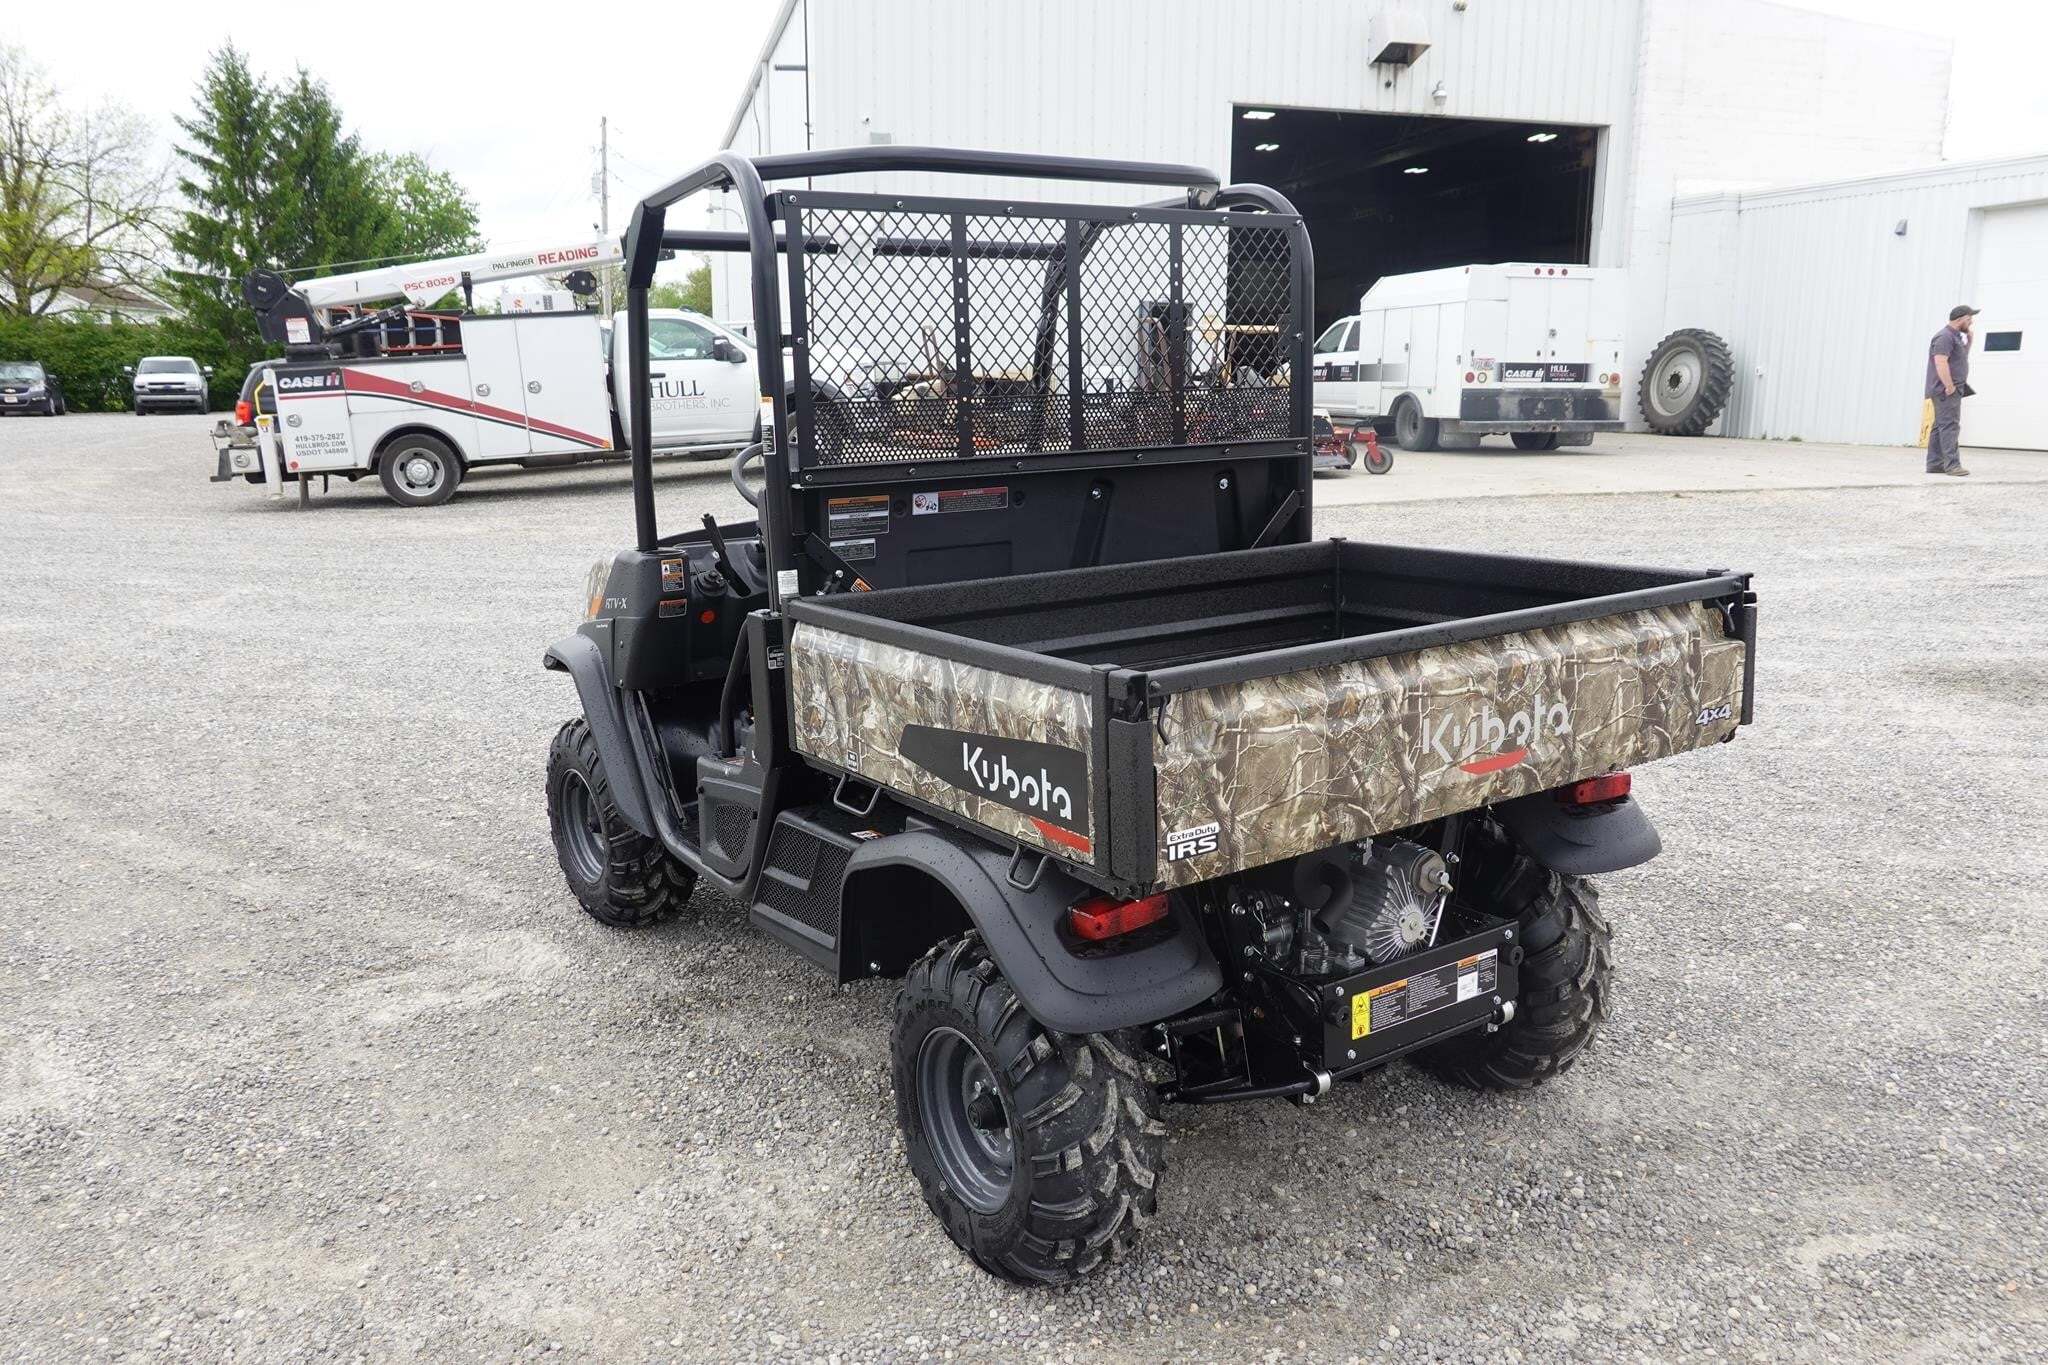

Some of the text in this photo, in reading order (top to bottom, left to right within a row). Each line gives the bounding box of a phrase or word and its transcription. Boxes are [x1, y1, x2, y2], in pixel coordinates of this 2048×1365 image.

[492, 246, 599, 271] PALFINGER READING
[404, 276, 455, 292] PSC 8029
[279, 375, 325, 389] CASE
[1505, 369, 1534, 378] CASE
[651, 379, 705, 399] HULL
[1695, 702, 1732, 726] 4x4
[1422, 693, 1573, 764] Kubota
[962, 741, 1073, 821] Kubota
[1170, 825, 1216, 842] Extra Duty
[1168, 834, 1217, 861] IRS
